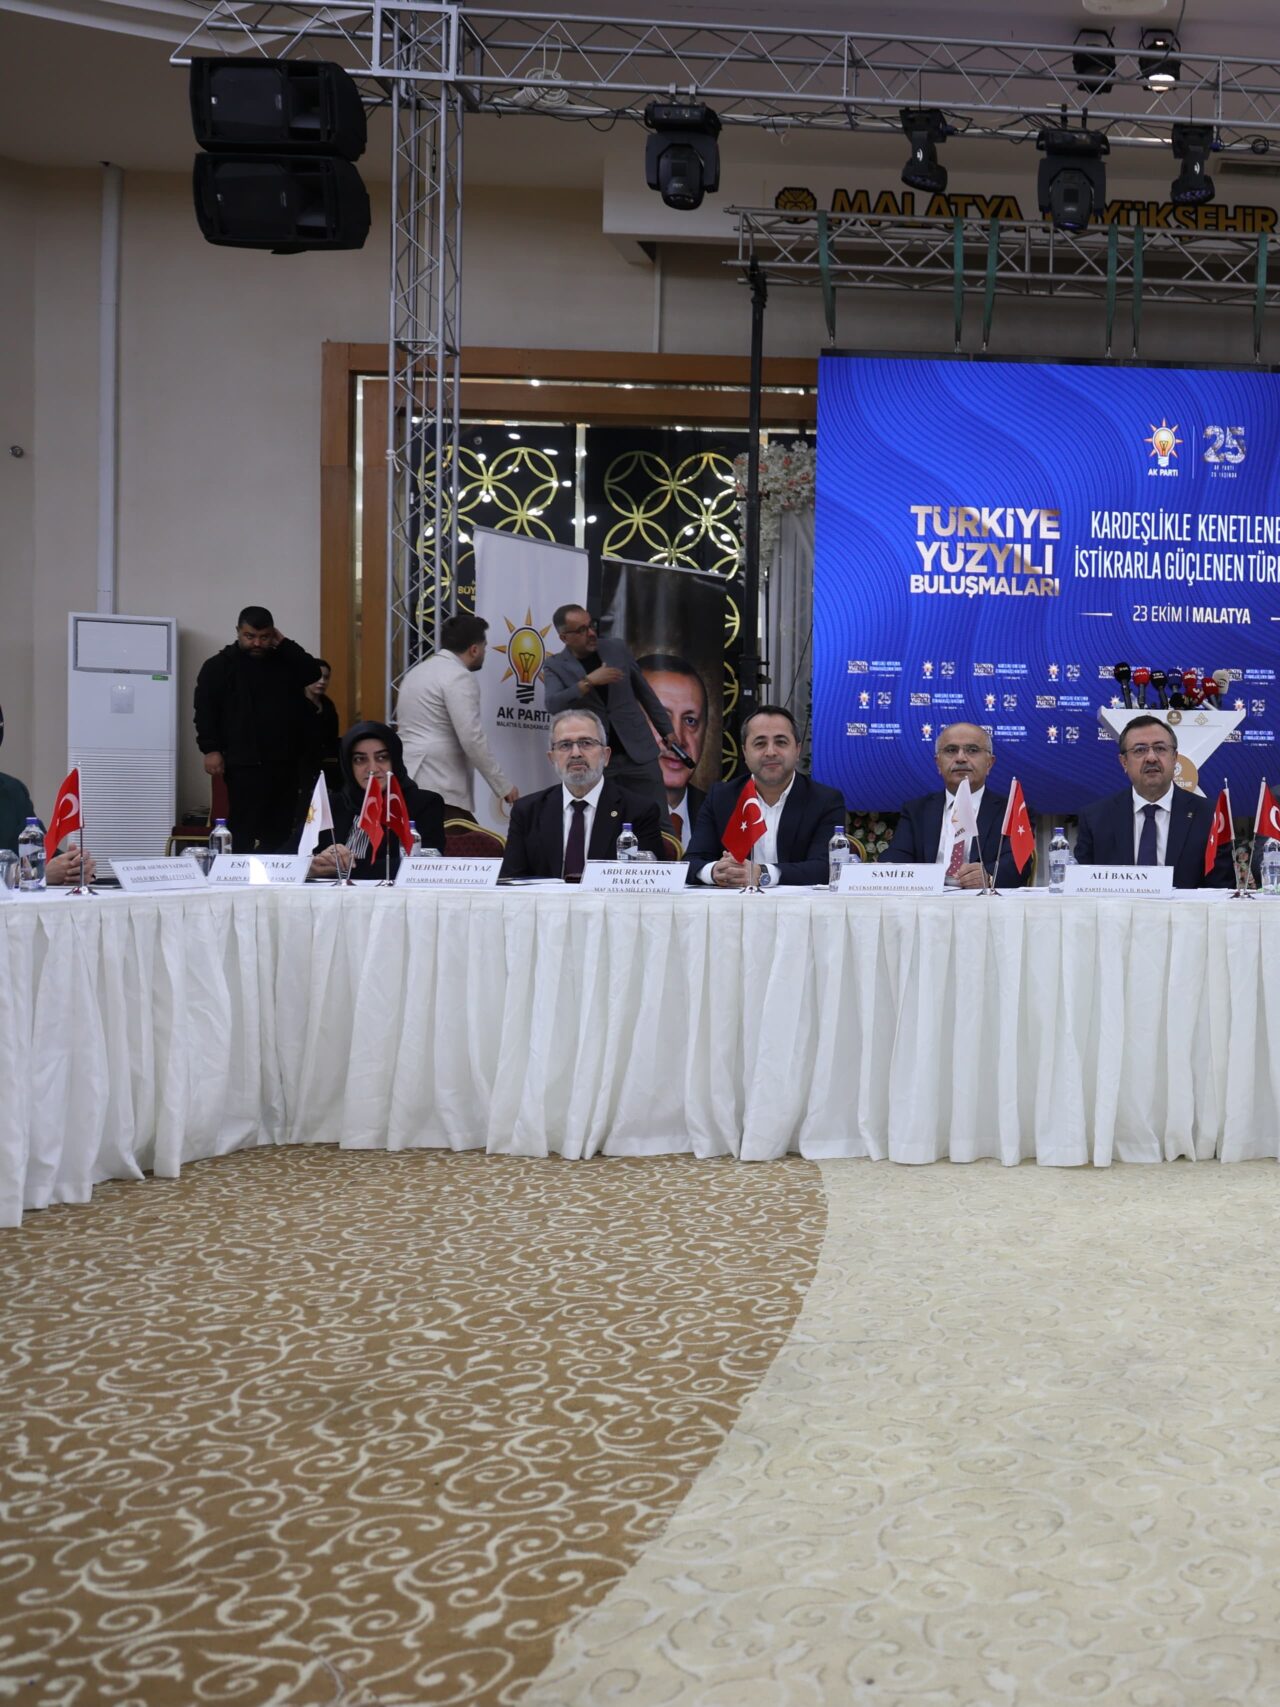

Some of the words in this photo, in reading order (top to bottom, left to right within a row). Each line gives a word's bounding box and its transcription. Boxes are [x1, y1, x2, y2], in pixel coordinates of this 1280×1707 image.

[830, 188, 1027, 232] MALATYA
[1043, 200, 1278, 245] YÜKŞEHİR
[1203, 425, 1246, 464] 25
[1148, 468, 1158, 476] AK
[1091, 508, 1192, 545] KARDEŞLİKLE
[1075, 545, 1162, 580] İSTİKRARLA
[1165, 547, 1244, 586] GÜÇLENEN
[910, 574, 1060, 598] BULUŞMALARI
[1132, 605, 1148, 622] 23
[1151, 602, 1182, 623] EKİM
[1192, 607, 1251, 624] MALATYA
[497, 706, 514, 719] AK
[518, 708, 550, 722] PARTİ
[451, 863, 472, 871] SAİT
[872, 869, 898, 878] SAMİ
[900, 870, 915, 878] ER
[1090, 871, 1109, 880] ALİ
[1111, 872, 1148, 880] BAKAN
